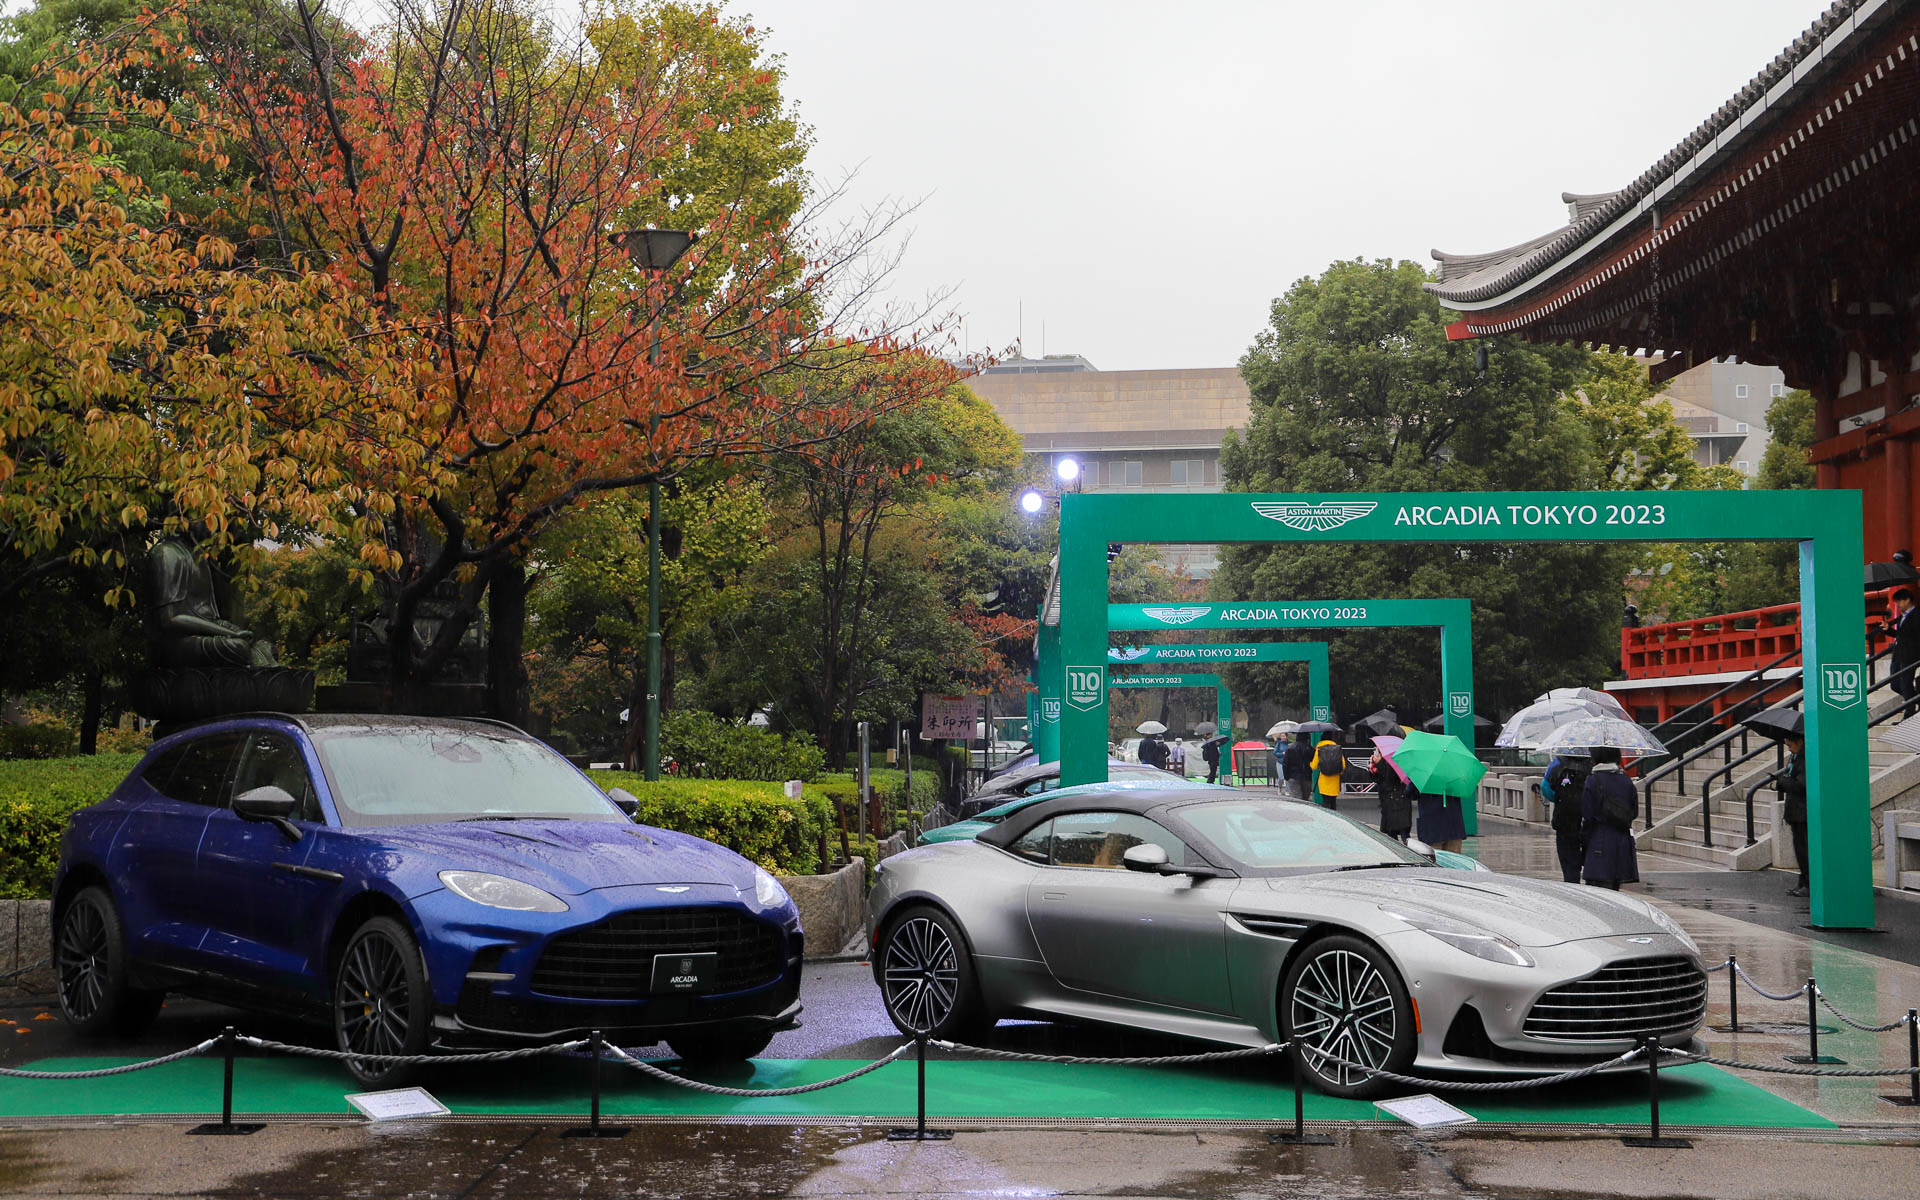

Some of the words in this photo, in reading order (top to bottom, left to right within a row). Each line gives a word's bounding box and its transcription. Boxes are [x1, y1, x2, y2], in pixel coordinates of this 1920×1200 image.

[1287, 508, 1312, 516] ASTON
[1313, 508, 1342, 516] MARTIN
[1394, 506, 1501, 526] ARCADIA
[1507, 505, 1597, 525] TOKYO
[1605, 504, 1666, 525] 2023
[1220, 609, 1278, 621] ARCADIA
[1281, 608, 1330, 620] TOKYO
[1334, 607, 1367, 619] 2023
[1155, 649, 1196, 658] ARCADIA
[1198, 648, 1232, 657] TOKYO
[1234, 648, 1257, 657] 2023
[1069, 672, 1100, 691] 110
[1824, 670, 1858, 689] 110
[1044, 701, 1060, 712] 110
[1452, 695, 1469, 707] 110
[927, 715, 973, 731] 朱印所
[670, 975, 698, 983] ARCADIA
